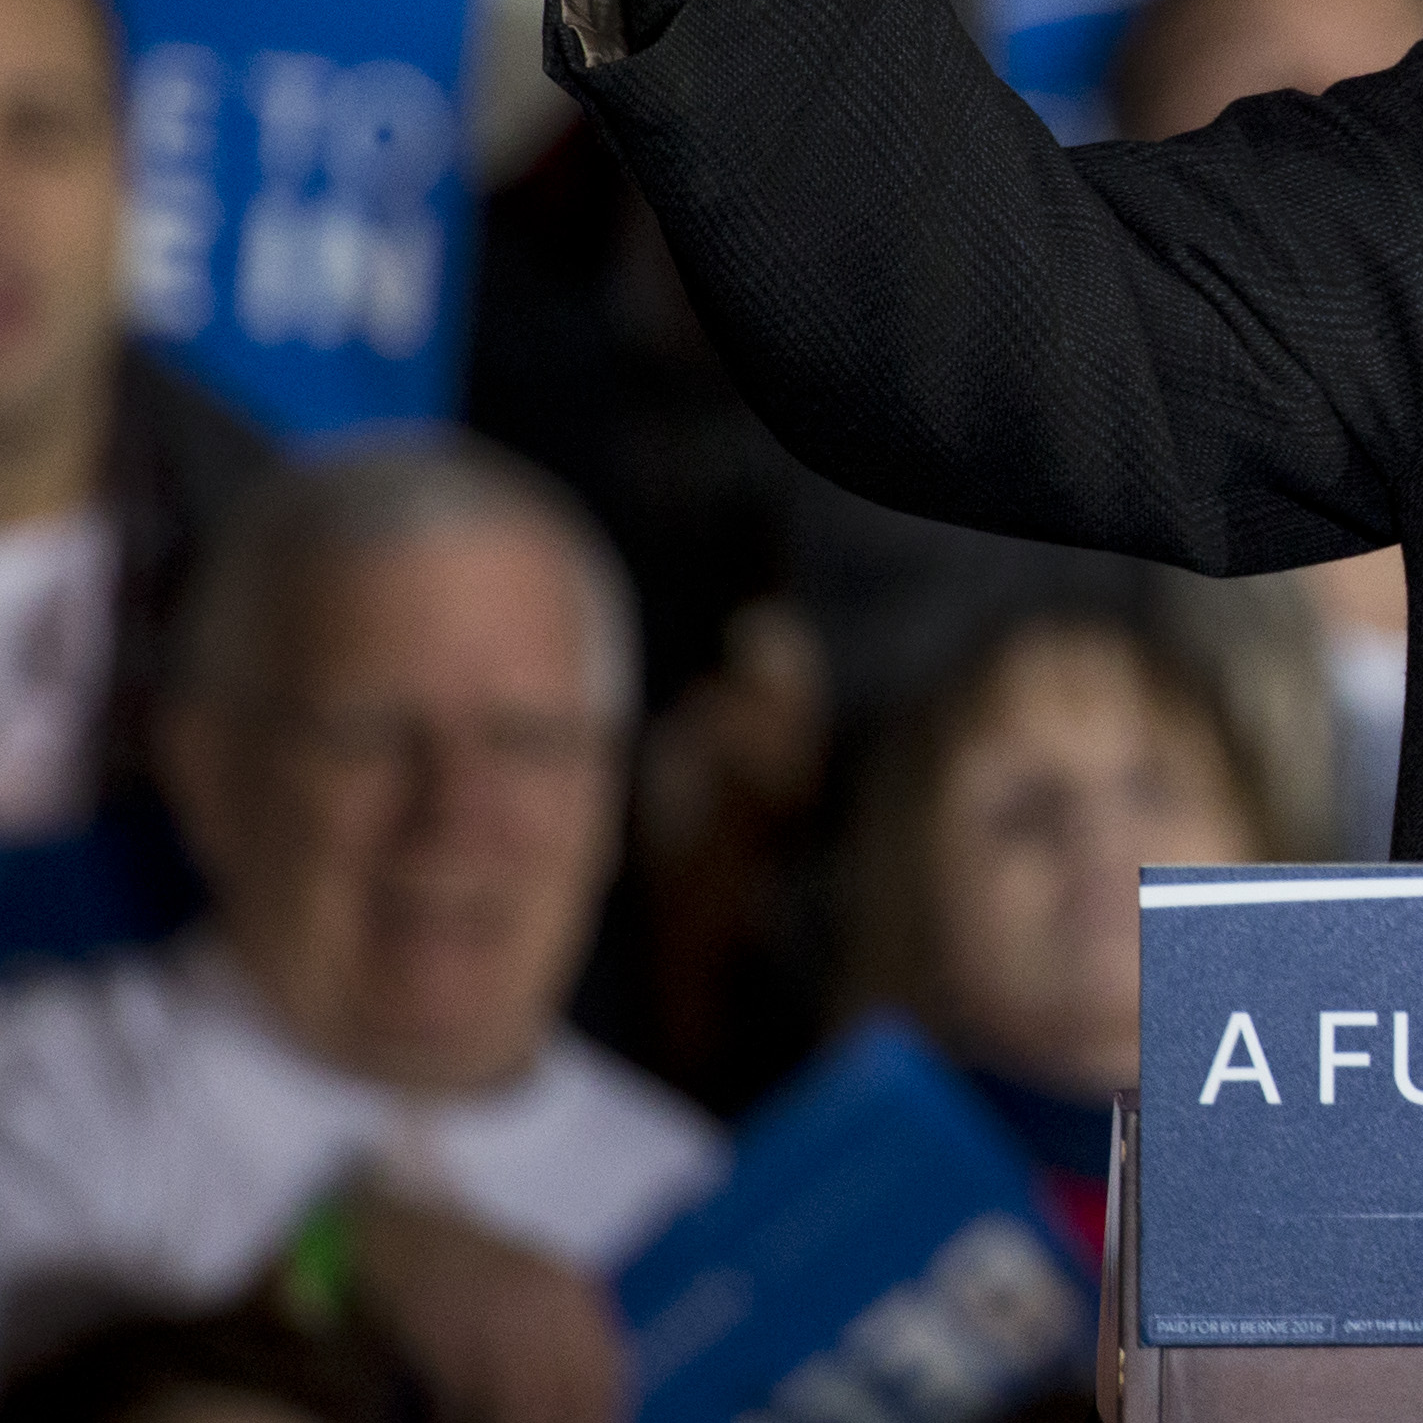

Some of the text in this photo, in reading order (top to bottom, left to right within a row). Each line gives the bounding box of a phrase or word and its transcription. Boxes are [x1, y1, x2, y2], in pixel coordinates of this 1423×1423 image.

[243, 49, 455, 197] TO
[235, 192, 445, 359] IN
[1199, 1011, 1283, 1106] A
[1156, 1319, 1325, 1334] PAID FOR BY BERNIE 2016
